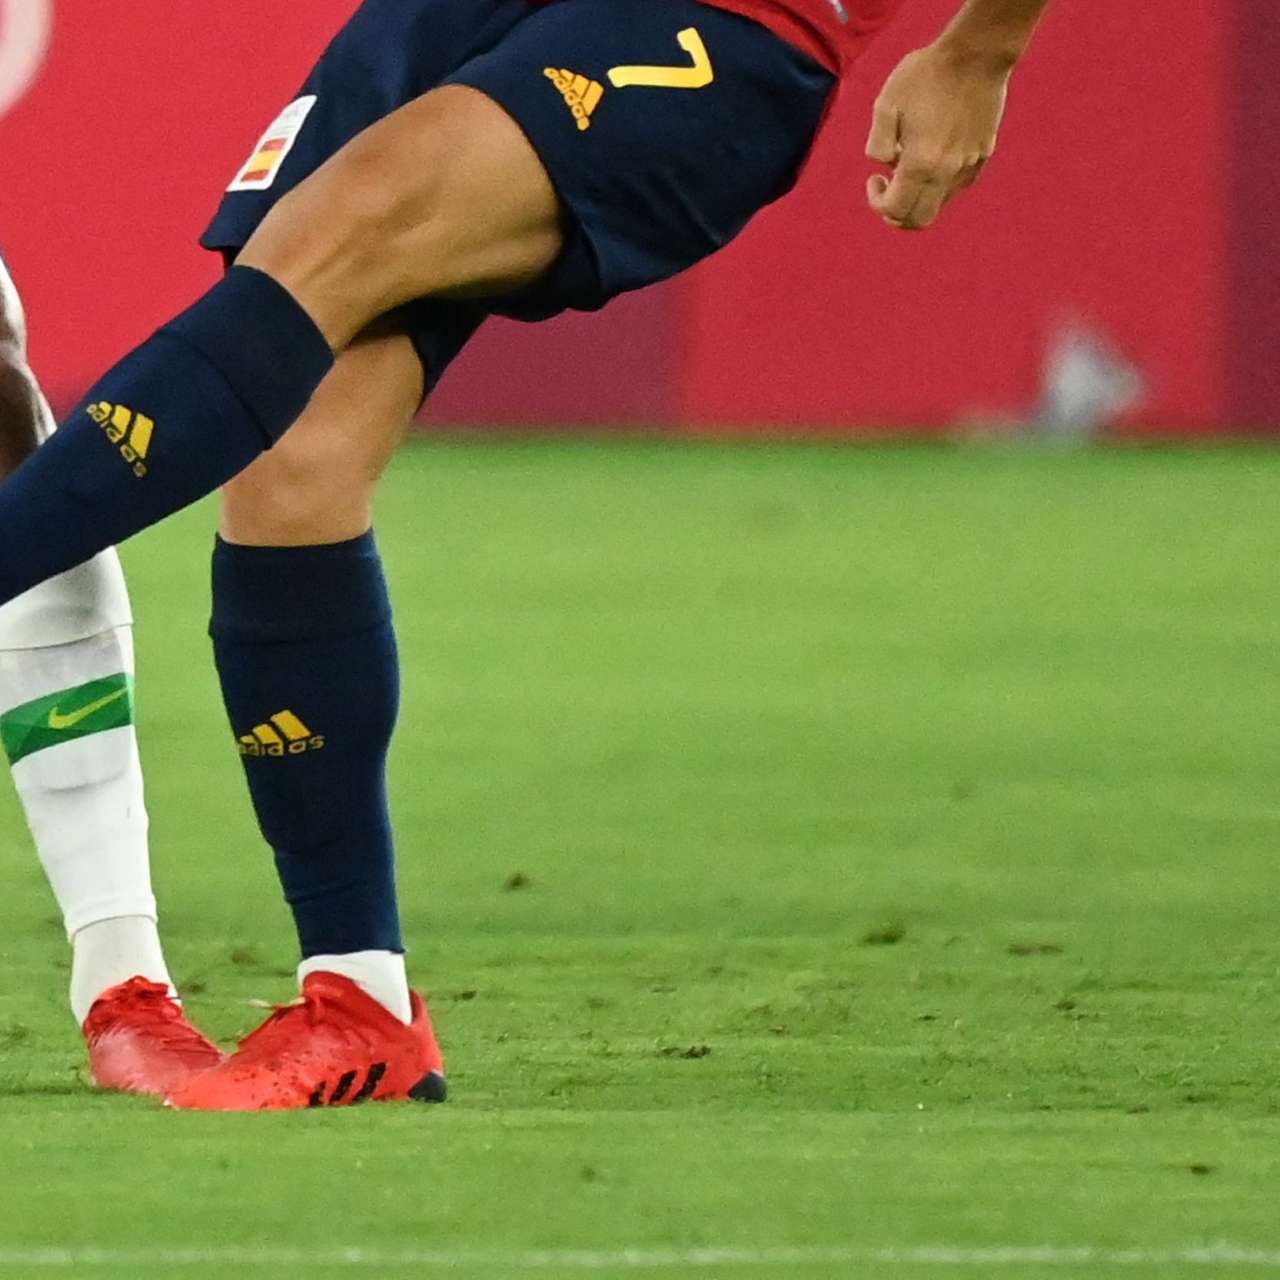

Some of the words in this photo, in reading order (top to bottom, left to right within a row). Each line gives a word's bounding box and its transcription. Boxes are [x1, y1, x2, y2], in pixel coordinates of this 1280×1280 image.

[607, 27, 713, 88] 7
[543, 67, 590, 131] adidas
[86, 403, 146, 477] adidas
